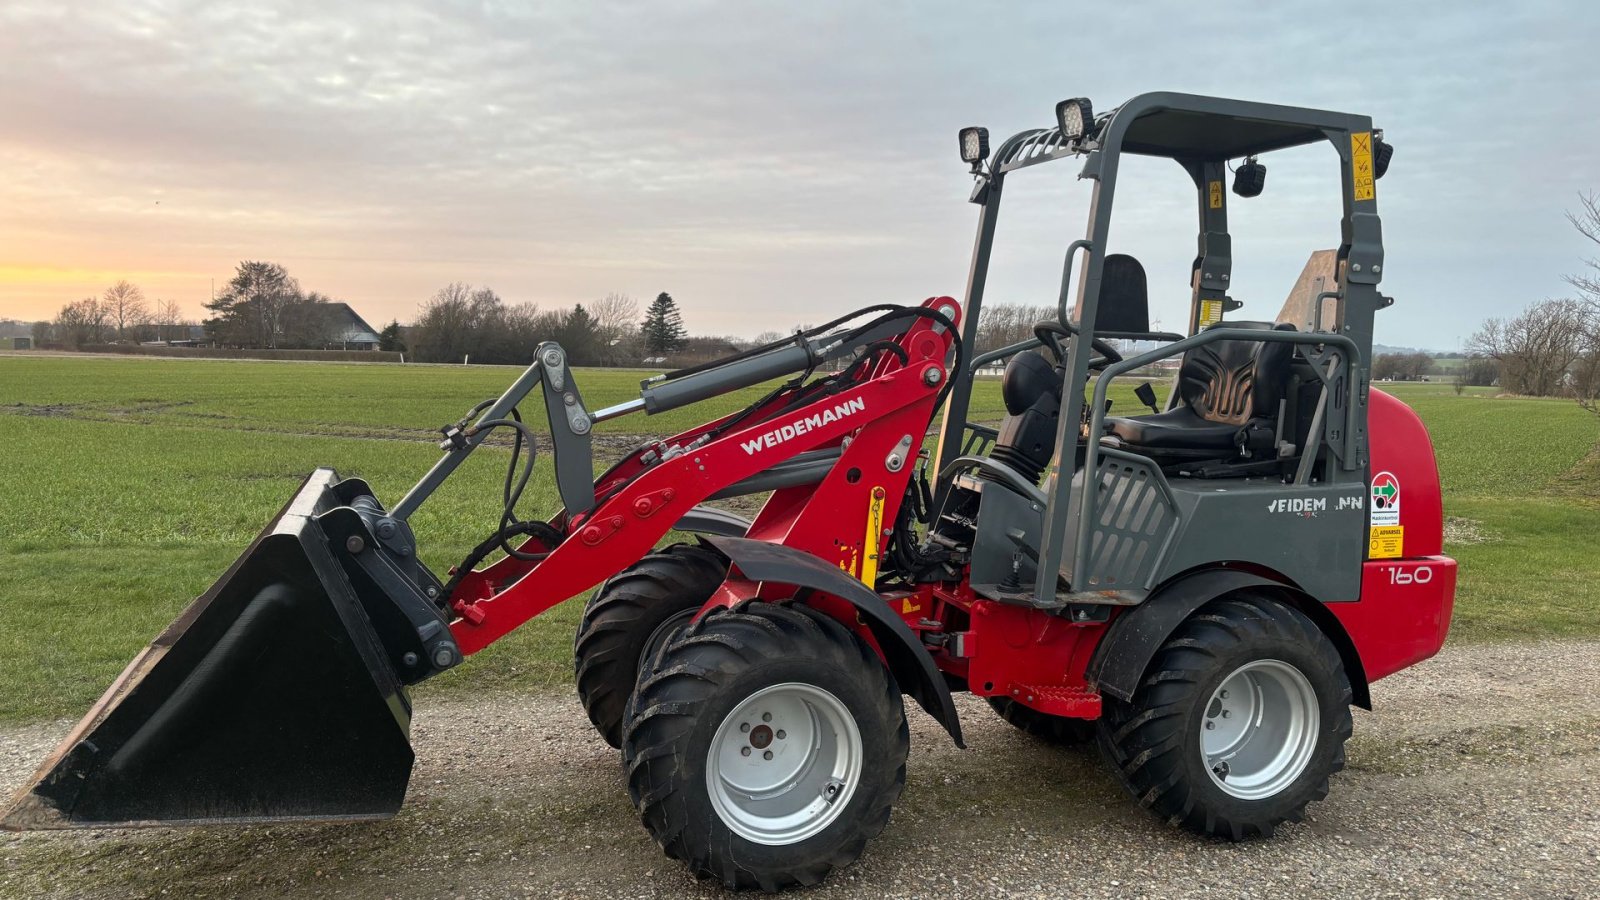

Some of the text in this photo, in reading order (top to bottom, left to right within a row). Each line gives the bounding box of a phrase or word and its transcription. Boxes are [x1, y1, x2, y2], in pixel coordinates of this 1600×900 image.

[740, 396, 865, 456] WEIDEMANN
[1267, 496, 1363, 513] EIDEMNN
[1381, 566, 1433, 585] 160
